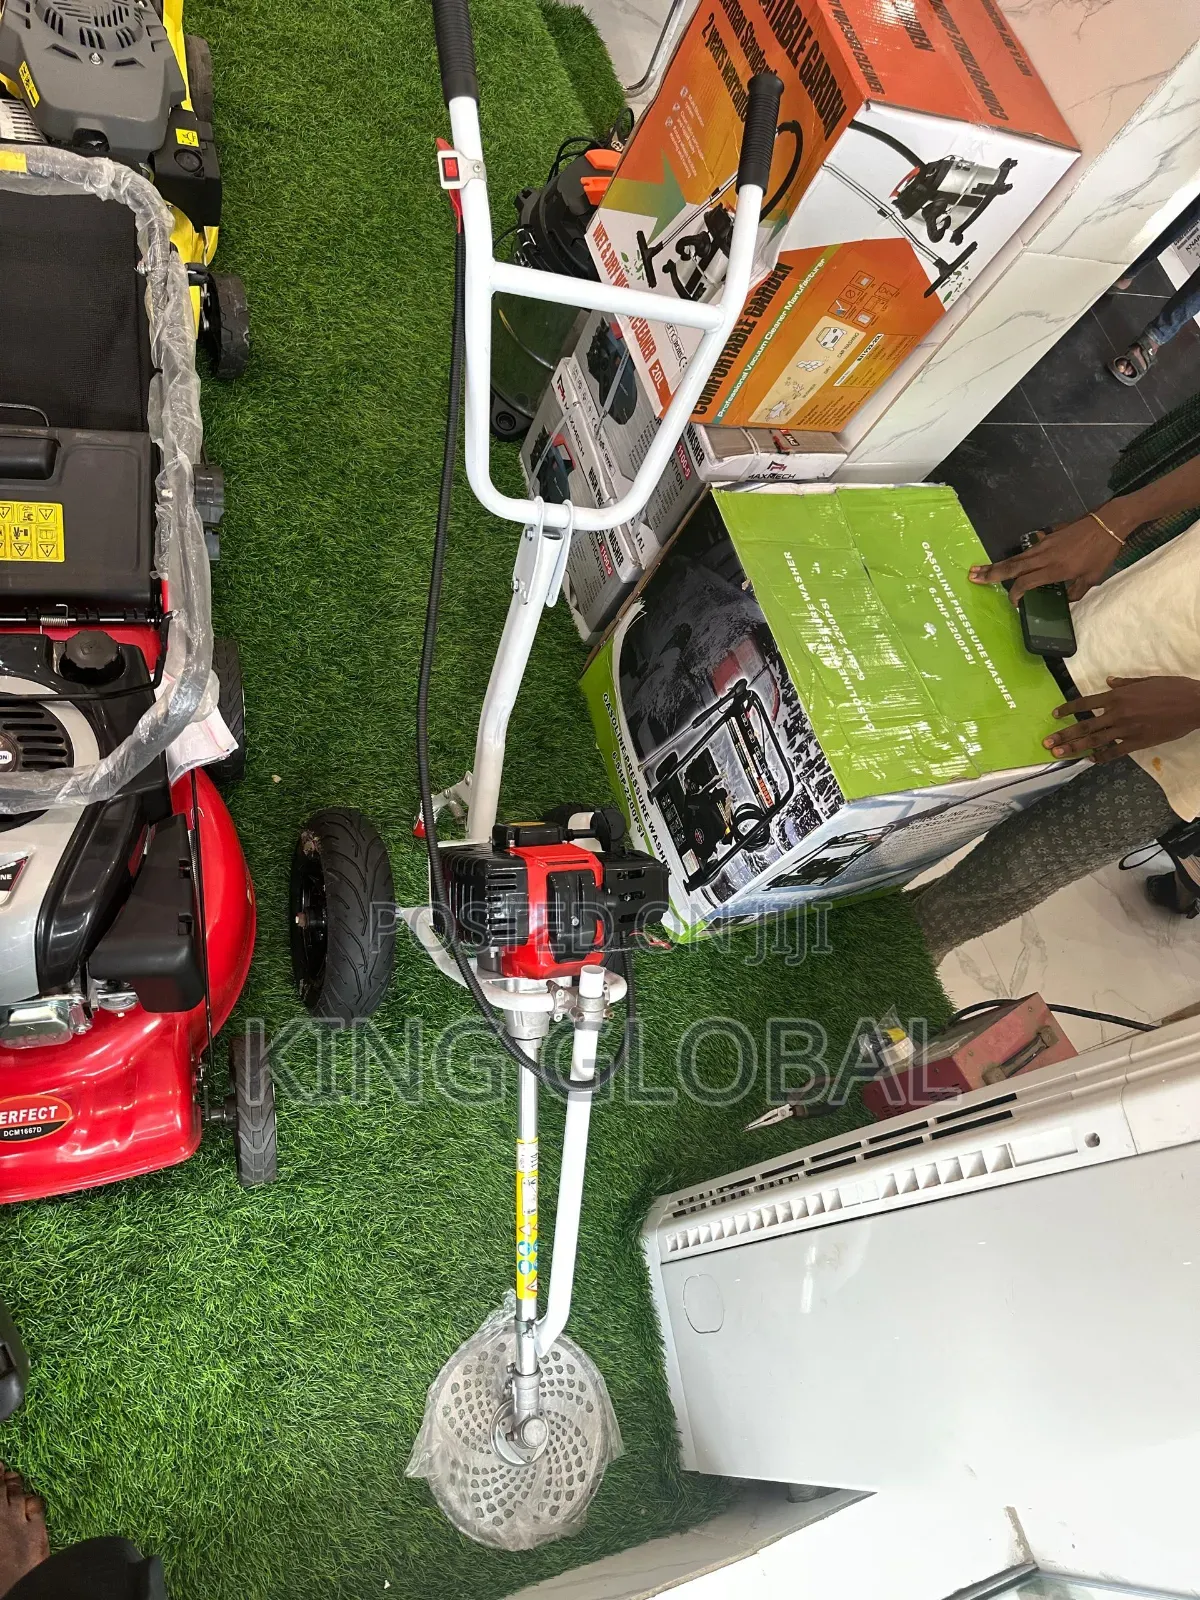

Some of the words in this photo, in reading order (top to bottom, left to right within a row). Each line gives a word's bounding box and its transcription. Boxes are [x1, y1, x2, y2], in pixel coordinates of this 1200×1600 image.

[701, 12, 714, 38] 2
[705, 24, 728, 70] years
[946, 31, 1009, 121] COMFORTABLE
[1012, 56, 1032, 77] WET
[593, 221, 608, 251] WET
[600, 243, 613, 262] &
[604, 252, 621, 280] DRY
[630, 316, 657, 364] CLEANER
[692, 316, 758, 415] COMFORTABLE
[744, 262, 794, 318] GARDEN
[718, 370, 749, 418] Professional
[746, 340, 768, 372] Vacuum
[766, 309, 787, 341] Cleaner
[785, 258, 826, 310] Manufacturer
[650, 363, 662, 389] 20L
[563, 401, 585, 457] MXMECH
[685, 422, 705, 467] WASHER
[588, 530, 606, 585] CIFICATION
[608, 527, 625, 568] WASHER
[784, 551, 811, 601] WASHER
[819, 598, 848, 645] 2200PSI
[921, 541, 955, 598] GASOLINE
[950, 598, 988, 658] PRESSURE
[984, 658, 1017, 709] WASHER
[928, 587, 950, 621] 6.5HP
[946, 620, 976, 665] 2200PSI
[838, 669, 876, 731] GASOLINE
[603, 693, 627, 755] GASOLINE
[624, 754, 649, 822] PRESSURE
[624, 788, 645, 838] 2200PSI
[3, 1126, 42, 1137] DCM1667D
